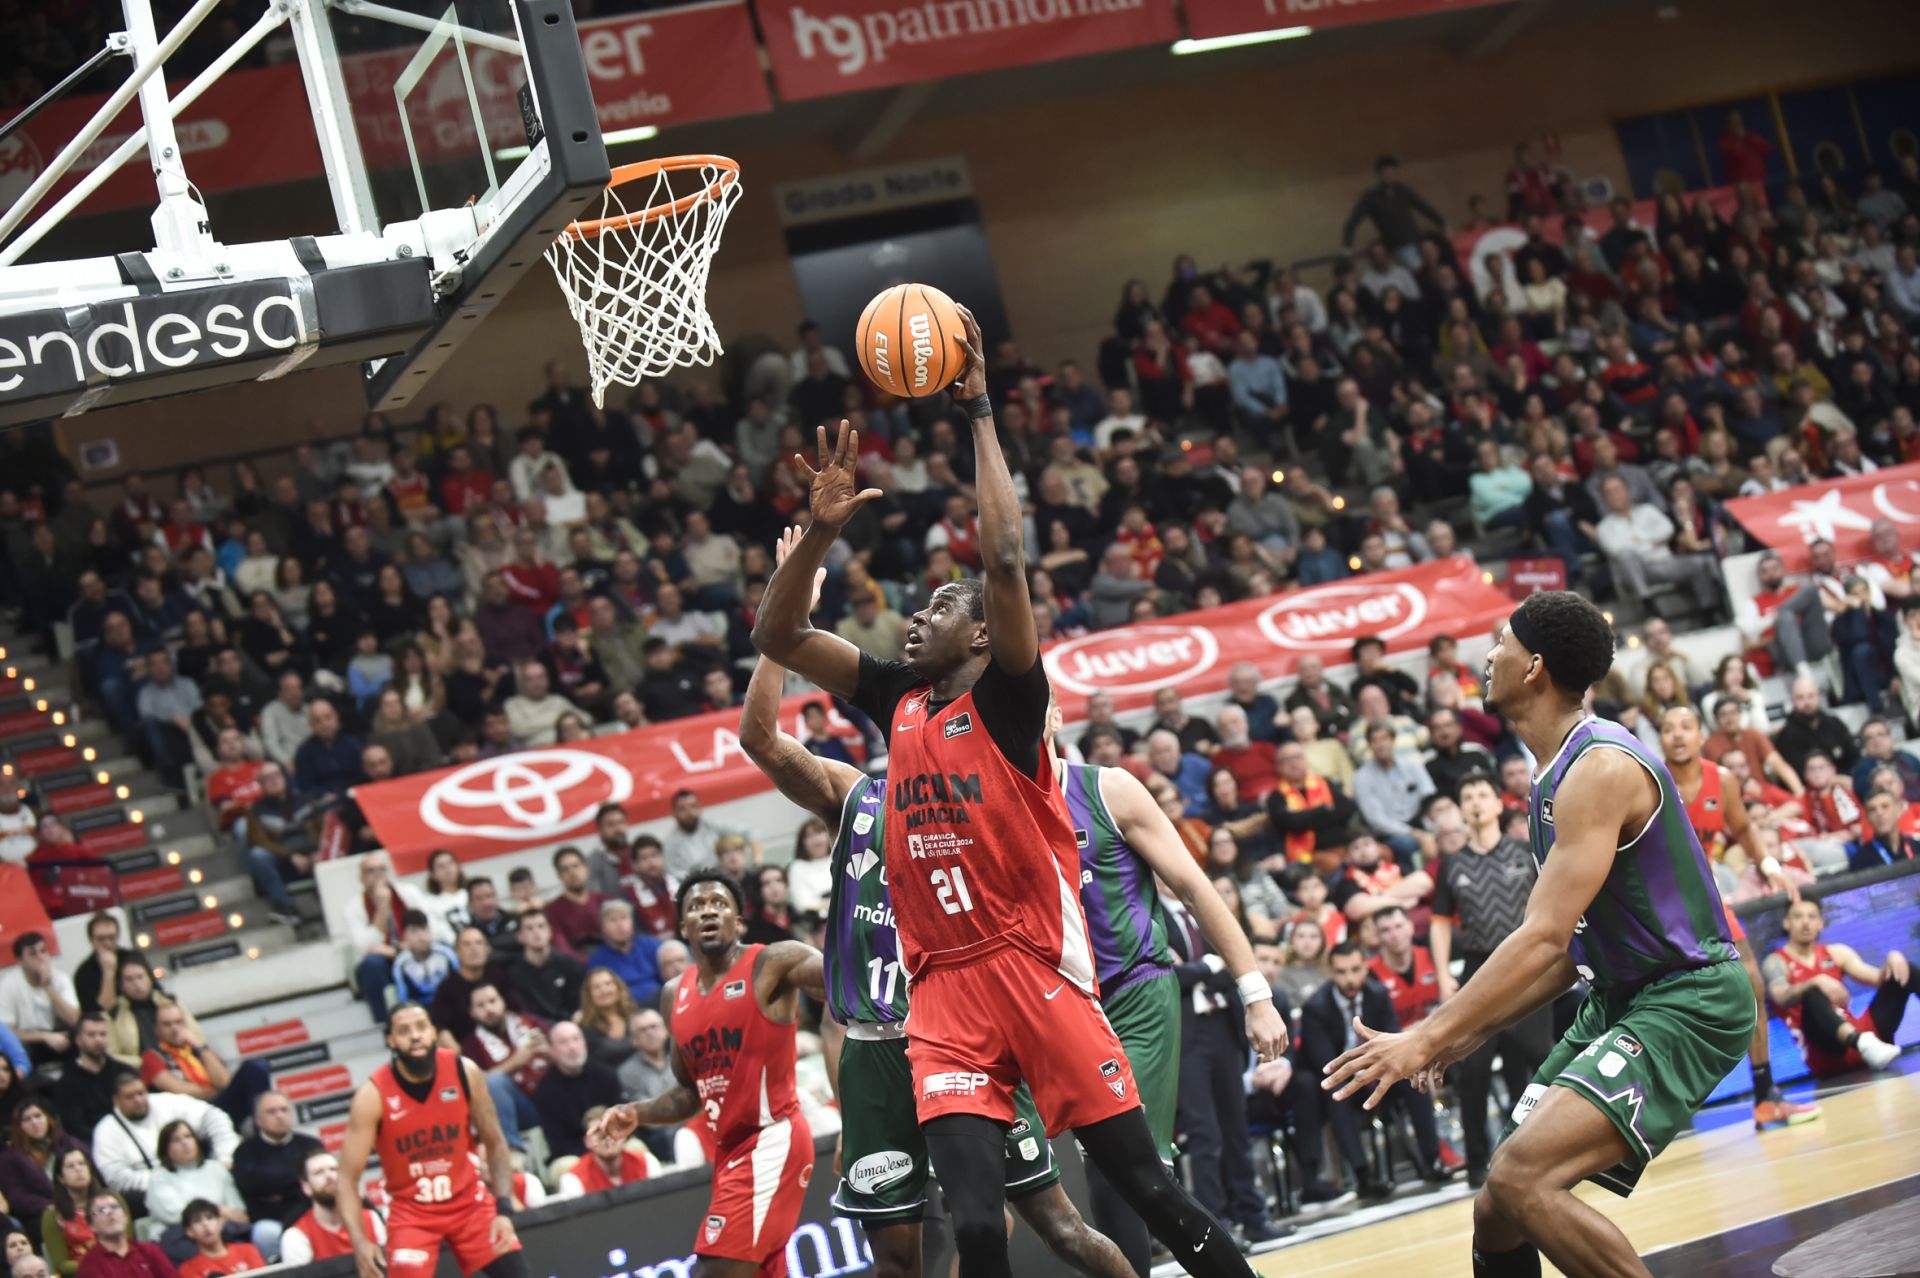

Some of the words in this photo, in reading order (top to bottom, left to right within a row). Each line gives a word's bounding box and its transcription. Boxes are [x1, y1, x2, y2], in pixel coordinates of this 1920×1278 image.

[909, 313, 934, 387] Wilson
[1283, 590, 1401, 640] Juver
[1070, 633, 1193, 682] Juver
[895, 773, 983, 811] UCAM
[906, 807, 971, 830] MURCIA
[930, 866, 974, 915] 21
[868, 956, 899, 1005] 11
[1617, 1038, 1635, 1052] acb
[396, 1123, 460, 1154] UCAM
[414, 1174, 453, 1203] 30
[852, 1155, 910, 1185] famadesa
